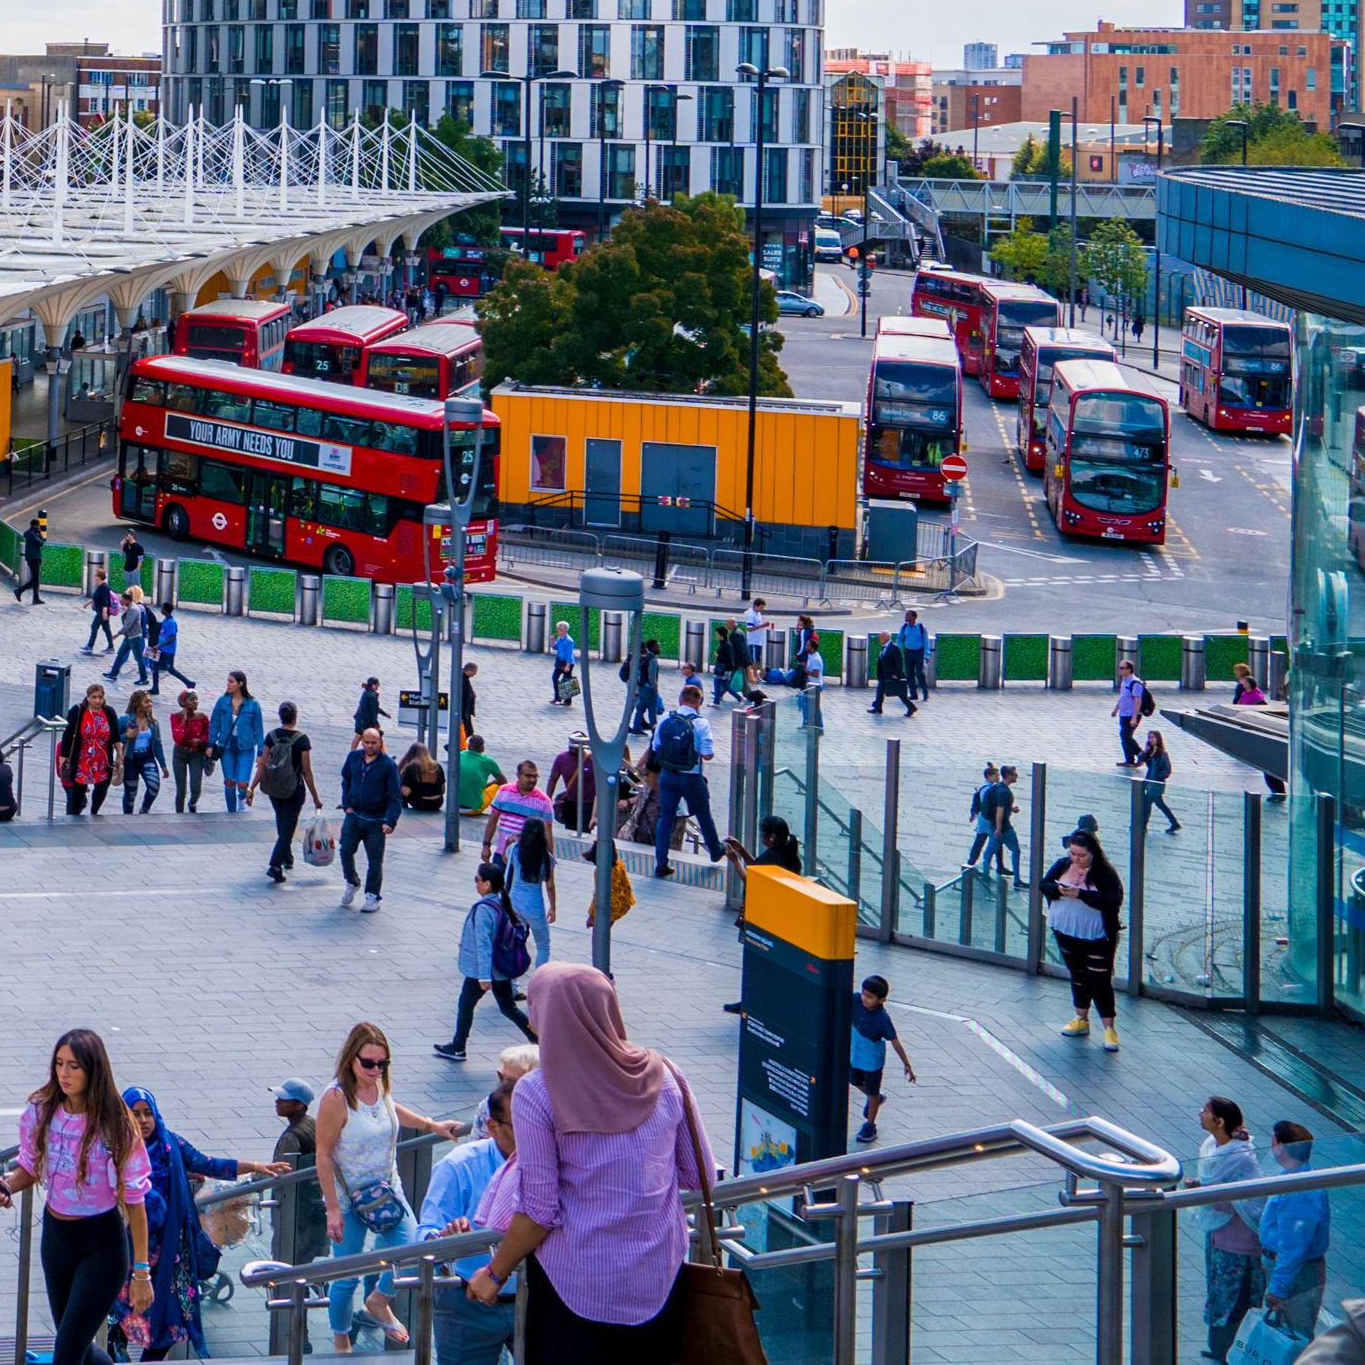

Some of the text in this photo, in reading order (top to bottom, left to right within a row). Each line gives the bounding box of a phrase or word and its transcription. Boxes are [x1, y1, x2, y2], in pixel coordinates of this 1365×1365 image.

[316, 360, 329, 371] 25
[395, 382, 409, 394] D8
[932, 410, 946, 421] 86
[189, 420, 295, 461] YOUR ARMY NEEDS YOU
[462, 450, 474, 463] 25
[1134, 447, 1150, 459] 473
